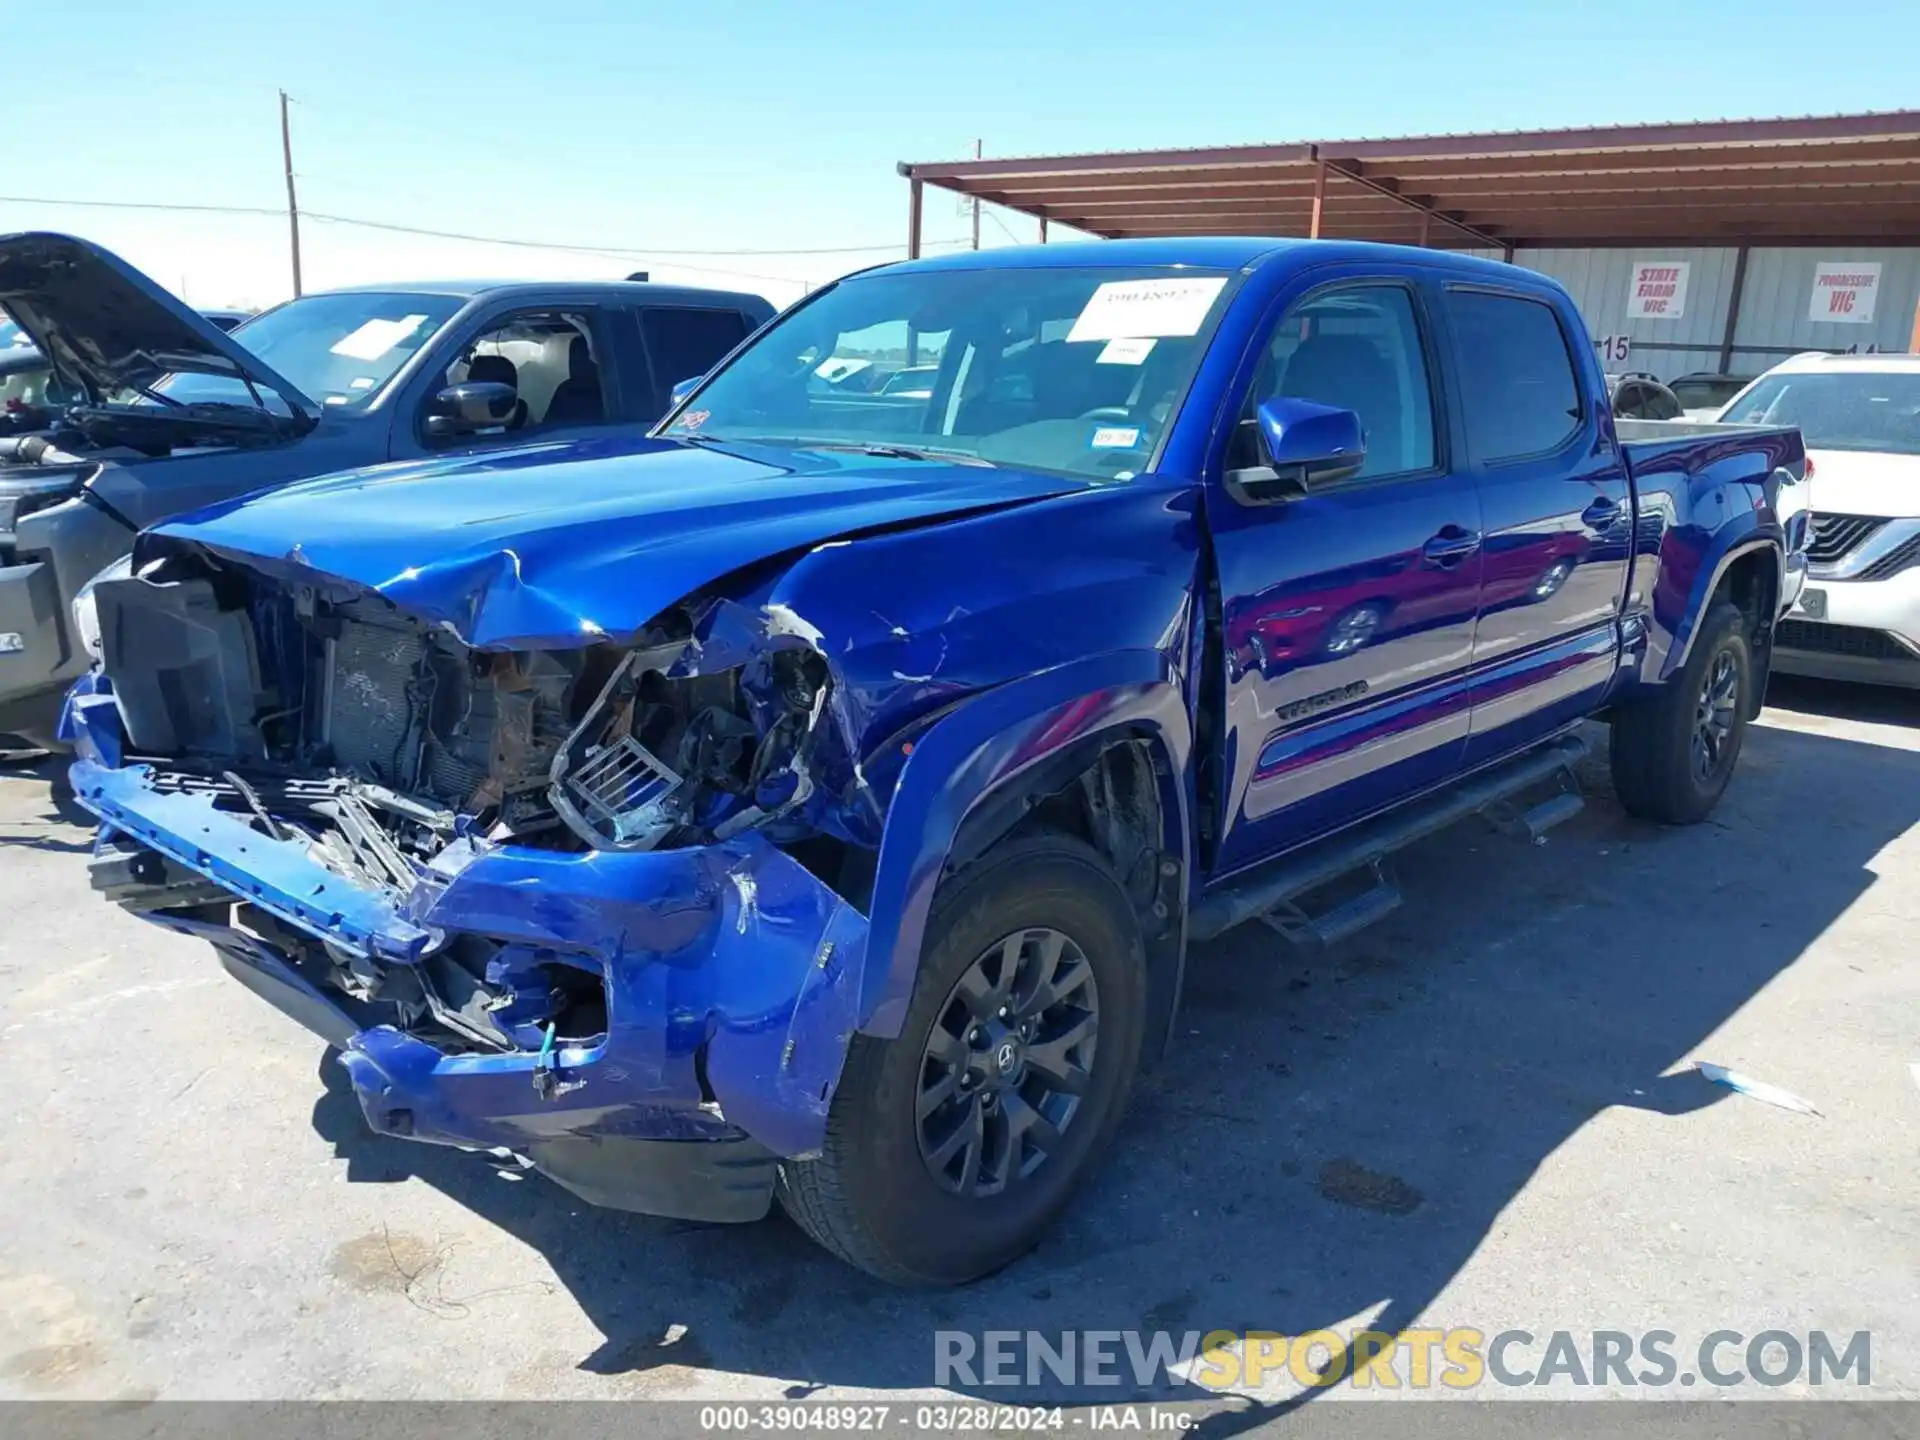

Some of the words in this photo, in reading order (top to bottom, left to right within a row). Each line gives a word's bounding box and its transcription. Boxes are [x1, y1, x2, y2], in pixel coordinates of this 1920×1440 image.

[1638, 268, 1680, 282] STATE
[1818, 274, 1875, 287] PROGRESSIVE
[1637, 284, 1676, 298] FARM
[1643, 299, 1668, 313] VIC
[1829, 290, 1856, 313] VIC
[1603, 336, 1628, 360] 15
